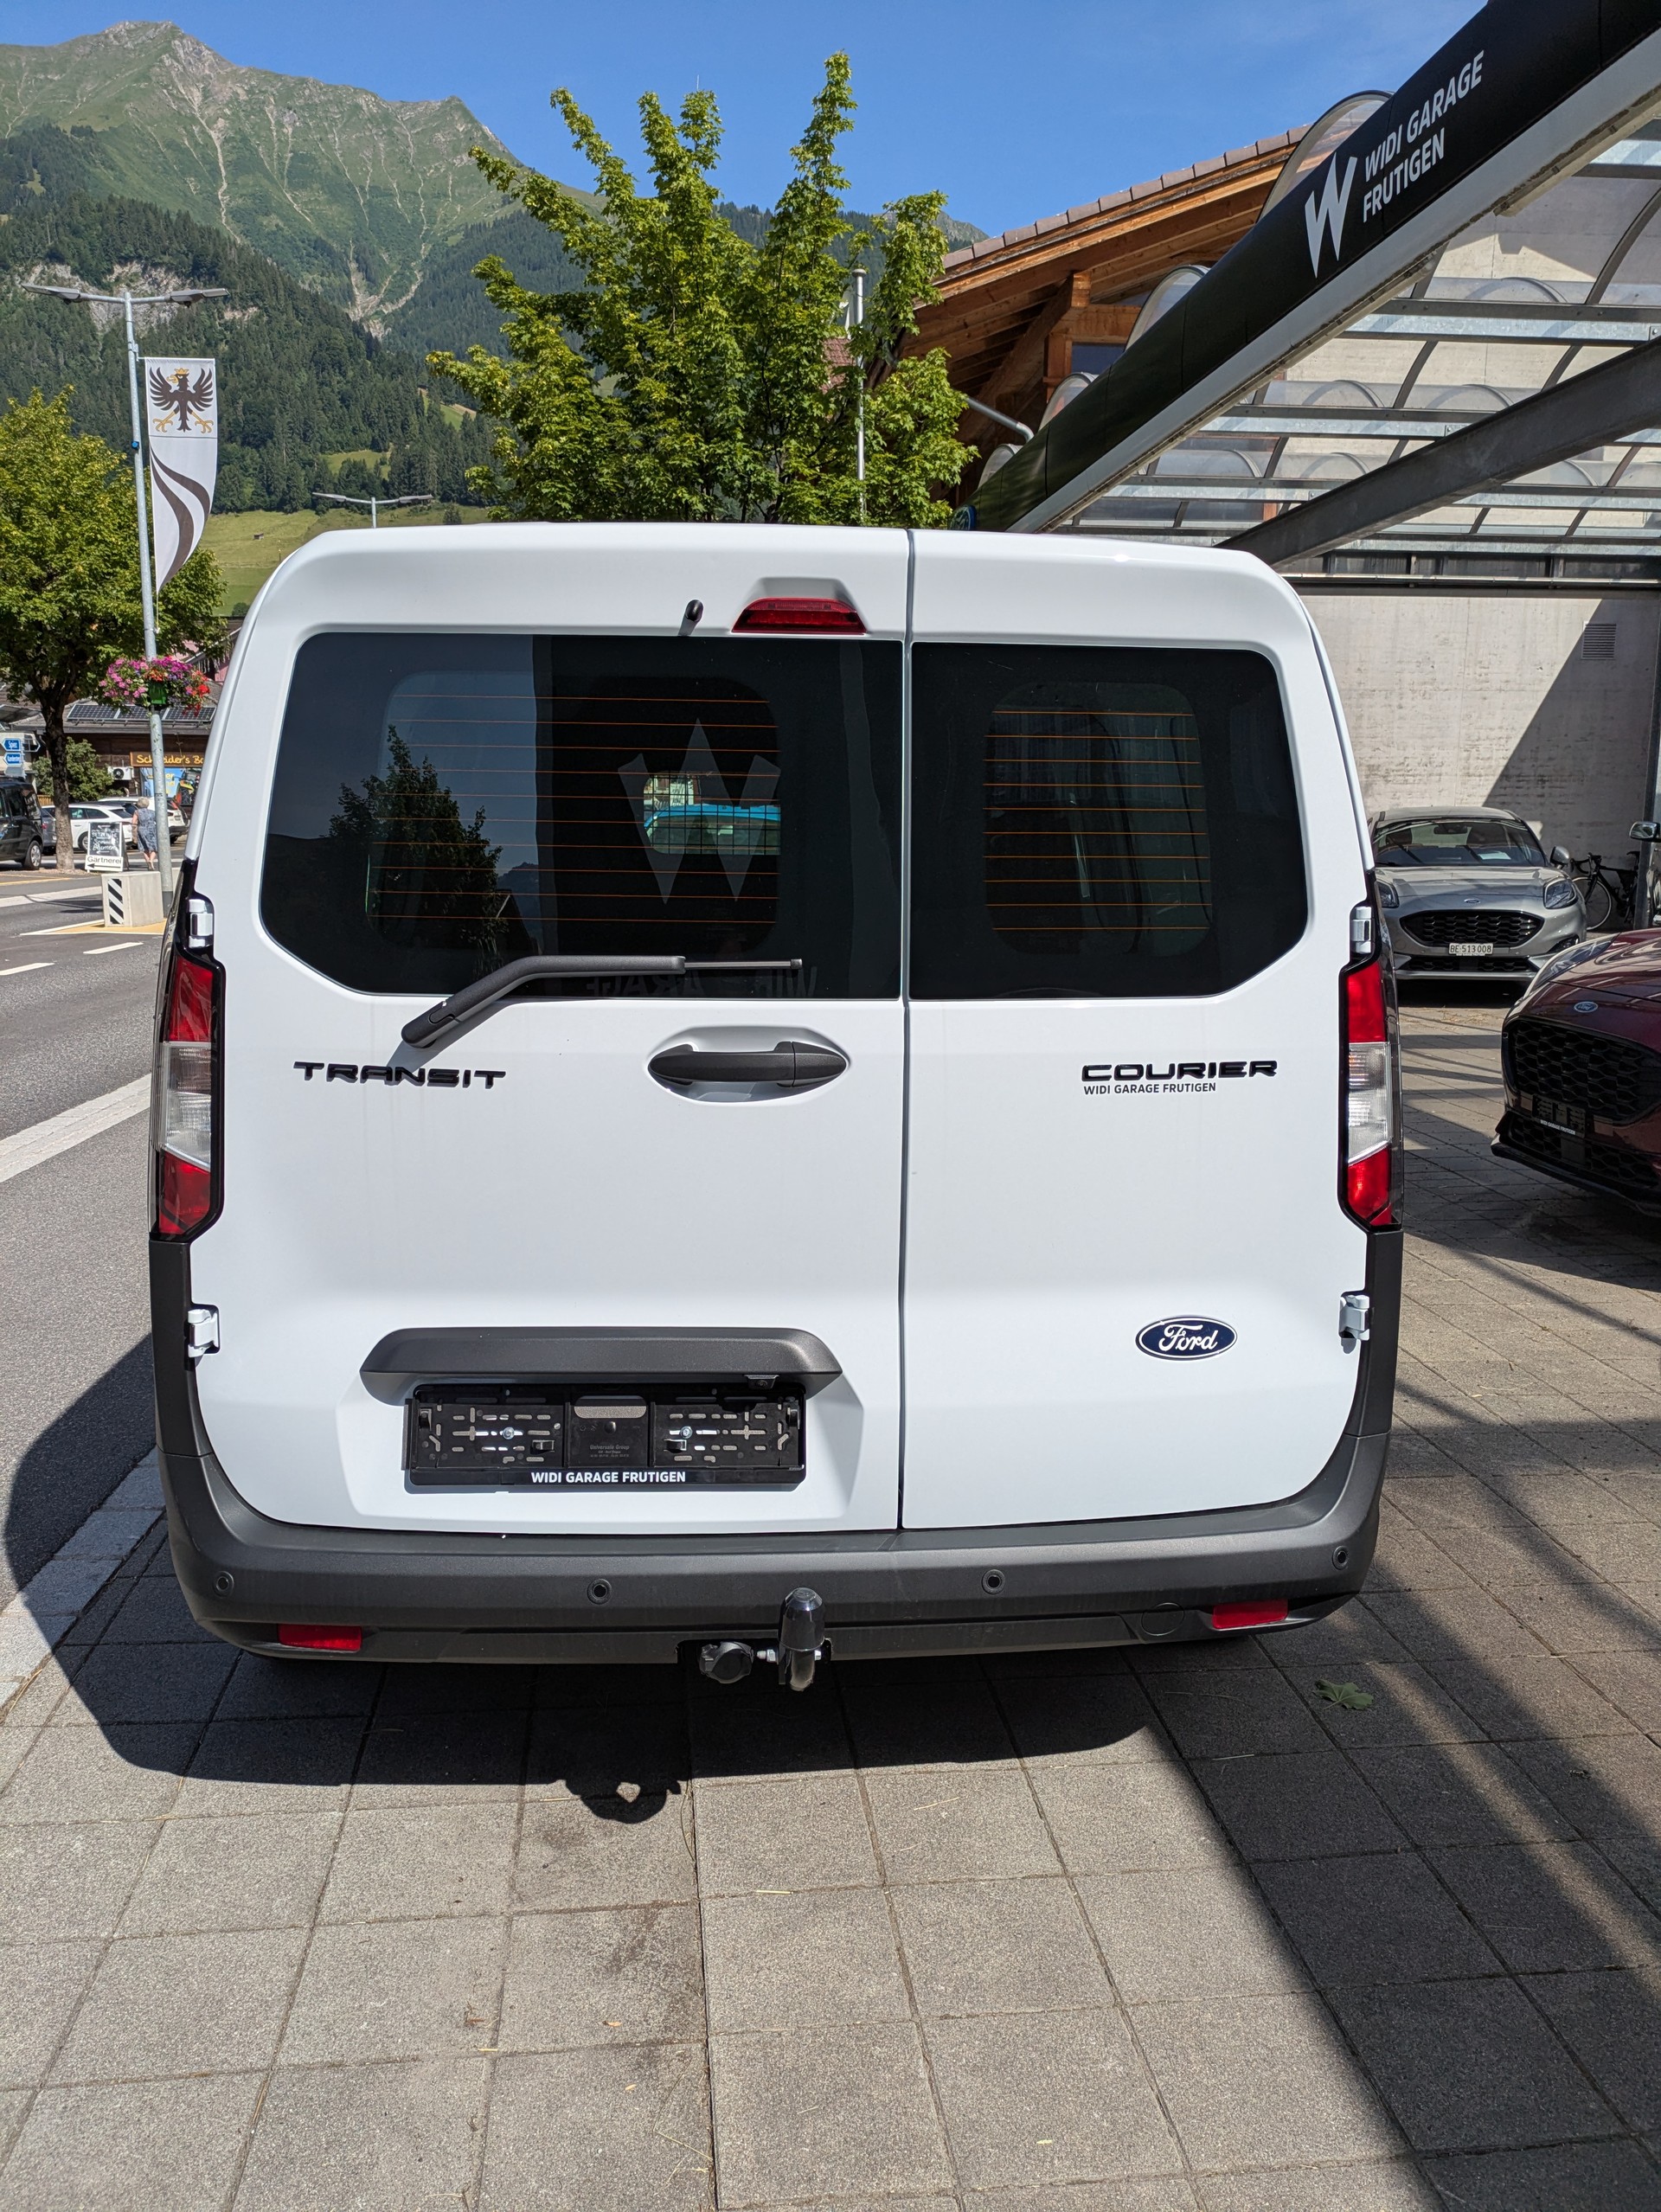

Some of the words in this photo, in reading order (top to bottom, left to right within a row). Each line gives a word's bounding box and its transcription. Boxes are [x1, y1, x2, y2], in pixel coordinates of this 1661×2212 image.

[1365, 124, 1403, 183] WIDI
[1407, 49, 1485, 144] GARAGE
[1363, 127, 1445, 223] FRUTIGEN
[87, 856, 122, 864] Gärtnerei
[293, 1061, 507, 1090] TRANSIT
[1081, 1060, 1278, 1082] COURIER
[1083, 1085, 1111, 1095] WIDI
[1113, 1084, 1160, 1094] GARAGE
[1163, 1082, 1216, 1093] FRUTIGEN
[1158, 1324, 1219, 1352] Ford
[530, 1471, 562, 1484] WIDI
[565, 1471, 619, 1484] GARAGE
[622, 1471, 686, 1483] FRUTIGEN
